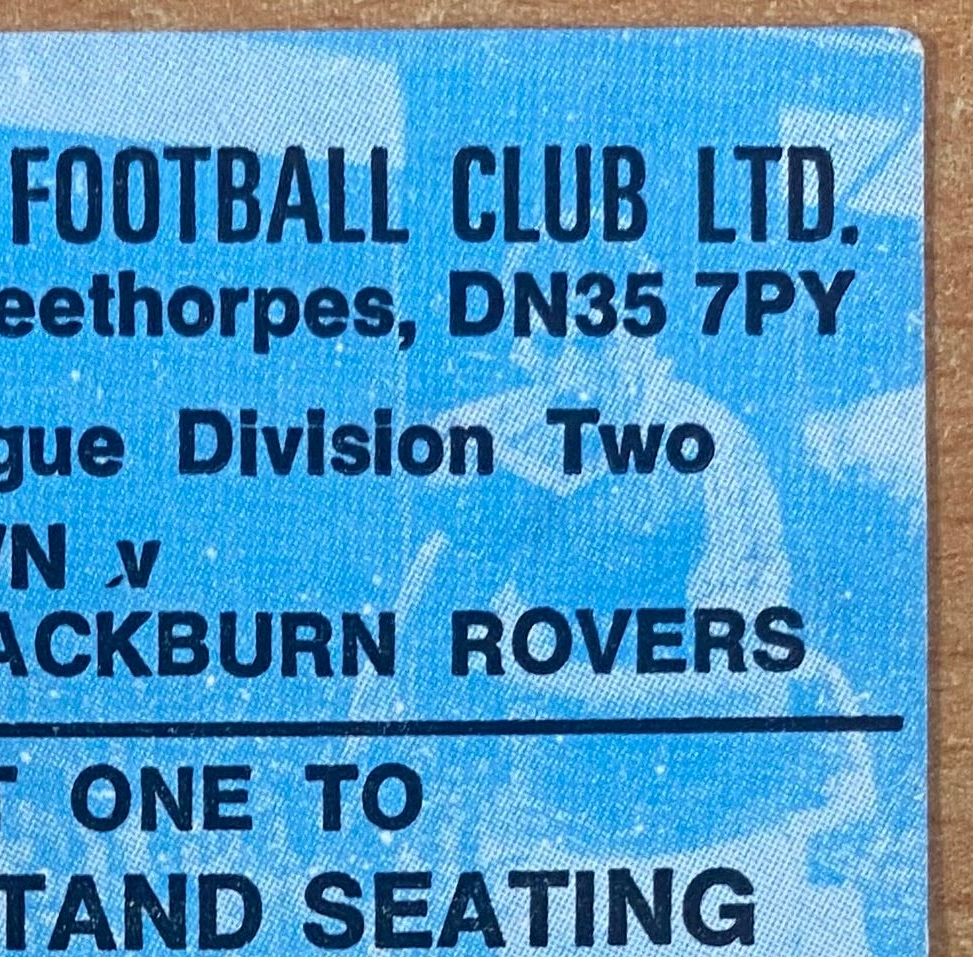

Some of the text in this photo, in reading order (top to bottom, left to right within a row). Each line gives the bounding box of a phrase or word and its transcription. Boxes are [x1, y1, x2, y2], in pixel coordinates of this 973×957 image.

[11, 146, 408, 244] FOOTBALL
[453, 146, 647, 242] CLUB
[699, 145, 858, 244] LTD.
[450, 271, 666, 337] DN35
[696, 271, 855, 335] 7PY
[179, 409, 493, 476] Division
[547, 409, 715, 475] Two
[452, 606, 805, 675] ROVERS
[71, 764, 252, 832] ONE
[305, 763, 422, 831] TO
[303, 867, 754, 949] SEATING
